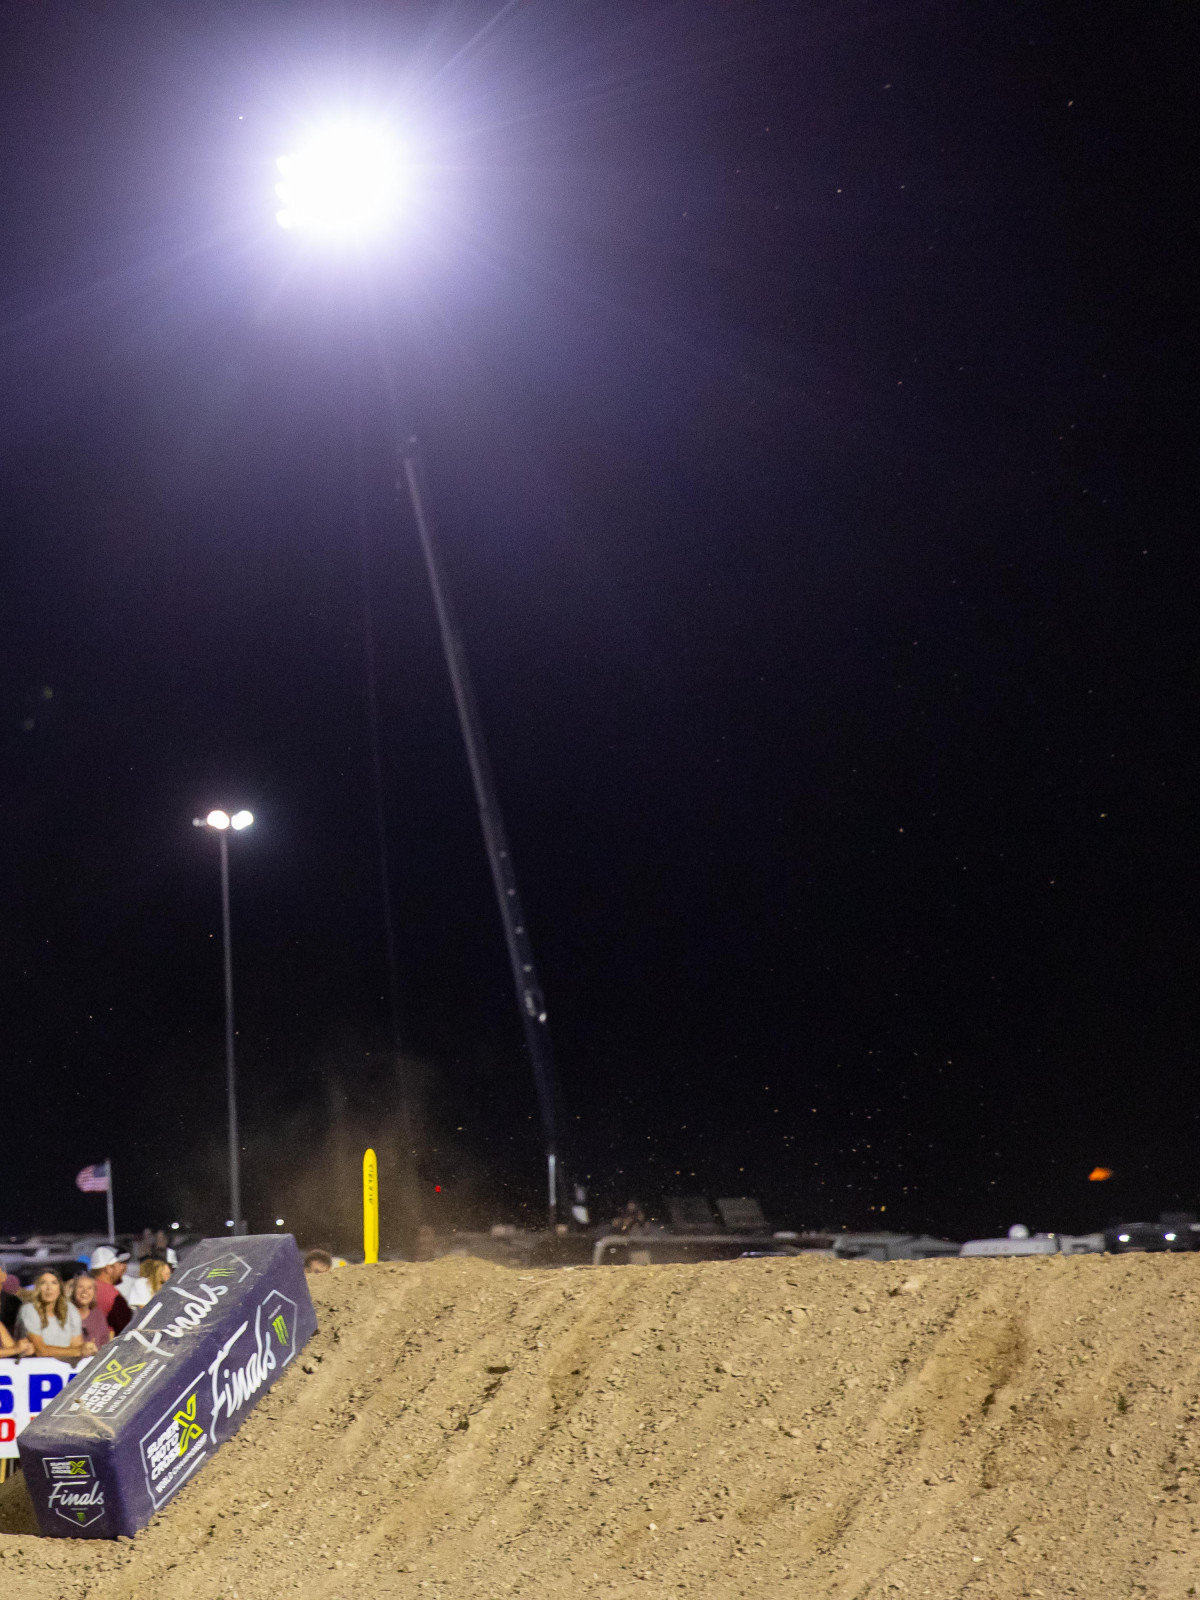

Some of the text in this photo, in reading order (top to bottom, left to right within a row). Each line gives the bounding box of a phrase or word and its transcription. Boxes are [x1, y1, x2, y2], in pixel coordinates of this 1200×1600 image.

[123, 1283, 229, 1358] Finals
[208, 1304, 277, 1445] Finals
[68, 1381, 103, 1412] SPER
[151, 1432, 180, 1468] MOTO
[48, 1480, 105, 1509] Finals
